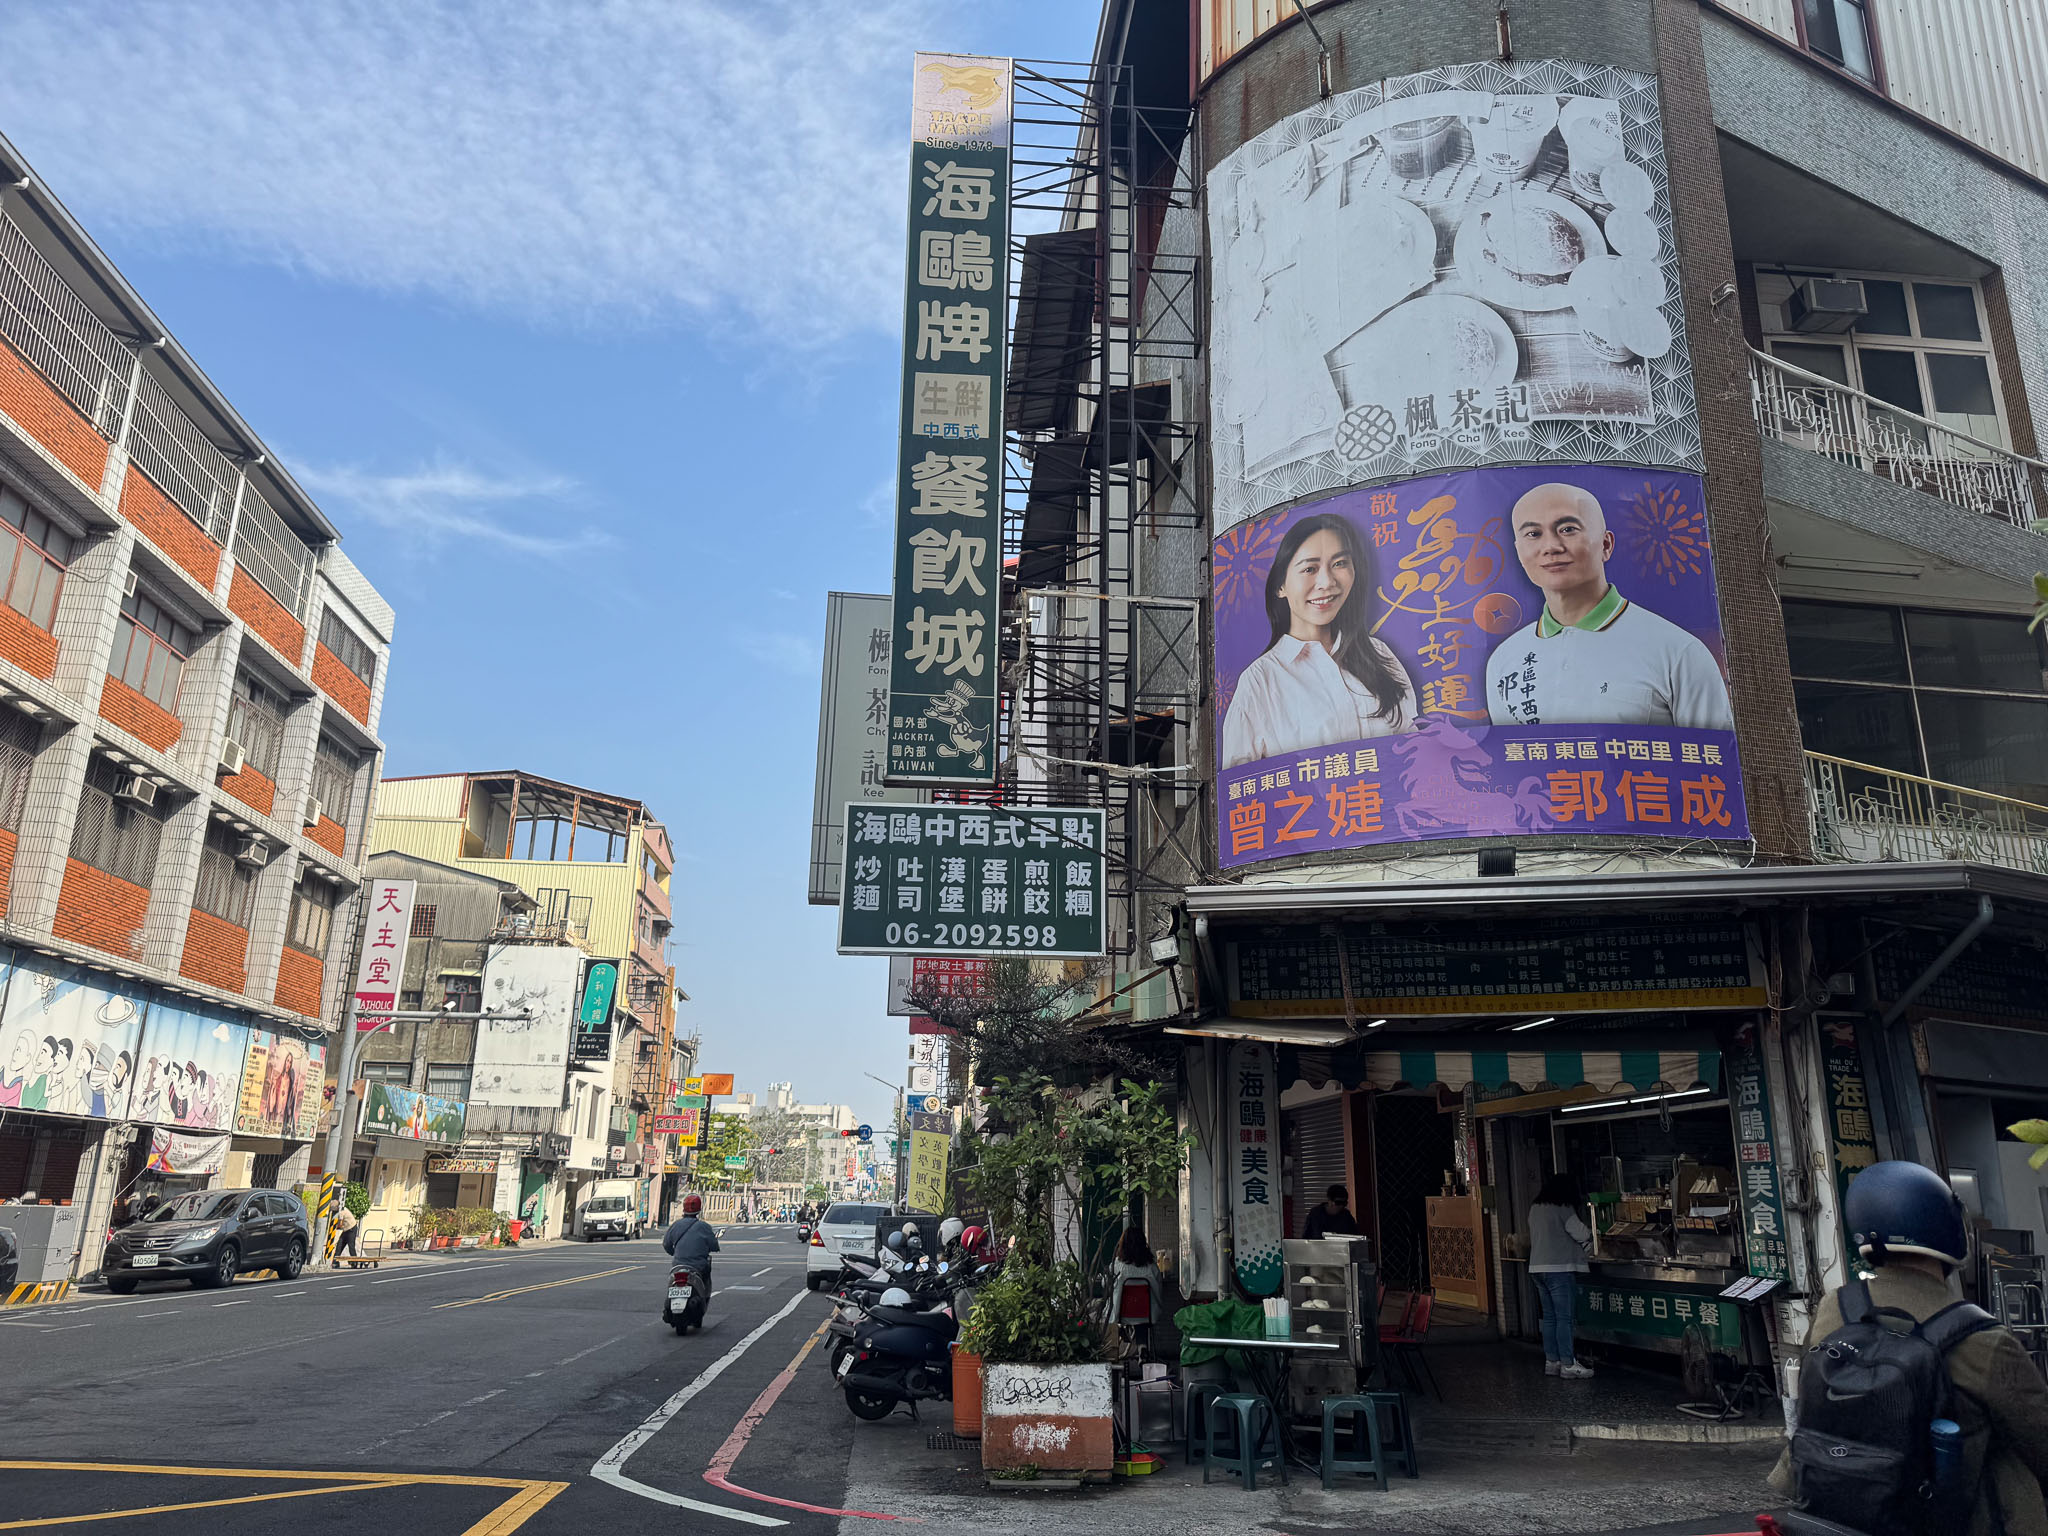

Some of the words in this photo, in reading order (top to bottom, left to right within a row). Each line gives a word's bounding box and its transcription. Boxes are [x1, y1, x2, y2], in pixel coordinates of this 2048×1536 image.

[925, 136, 960, 149] Since
[964, 140, 993, 152] 1978
[916, 160, 996, 363] 海鷗牌
[920, 381, 983, 417] 生鮮
[1403, 385, 1530, 437] 楓茶記
[923, 422, 980, 440] 中西式
[1410, 437, 1437, 451] Fong
[1457, 434, 1481, 444] Cha
[1503, 429, 1526, 439] Kee
[1370, 492, 1400, 547] 敬祝
[905, 451, 988, 677] 餐飲城
[893, 716, 928, 728] 國外部
[892, 745, 927, 758] 國內部
[892, 759, 935, 772] TAIWAN
[1228, 780, 1257, 801] 臺南
[1260, 772, 1291, 792] 東區
[1296, 747, 1381, 785] 市議員
[1505, 742, 1548, 764] 臺南
[1555, 741, 1598, 762] 東區
[1604, 738, 1672, 764] 中西里
[1681, 741, 1724, 767] 里長
[863, 787, 885, 798] Kee
[1228, 780, 1385, 856] 曾之婕
[1545, 769, 1733, 828] 郭信成
[853, 811, 1094, 849] 海鷗中西式早點
[853, 855, 882, 911] 炒麵
[897, 857, 924, 912] 吐司
[938, 857, 967, 913] 漢堡
[981, 859, 1008, 914] 蛋餅
[1023, 860, 1050, 915] 煎餃
[366, 888, 402, 985] 天主堂
[885, 922, 1057, 947] 06-2092598
[916, 959, 995, 973] 郭地政士事務
[360, 1000, 392, 1011] ATHOLIC
[1239, 1071, 1265, 1127] 海鷗
[1735, 1076, 1766, 1141] 海鷗
[1241, 1147, 1269, 1205] 美食
[1741, 1143, 1771, 1162] 生鮮
[1747, 1165, 1778, 1236] 美食
[1588, 1290, 1721, 1326] 新鮮當日早餐
